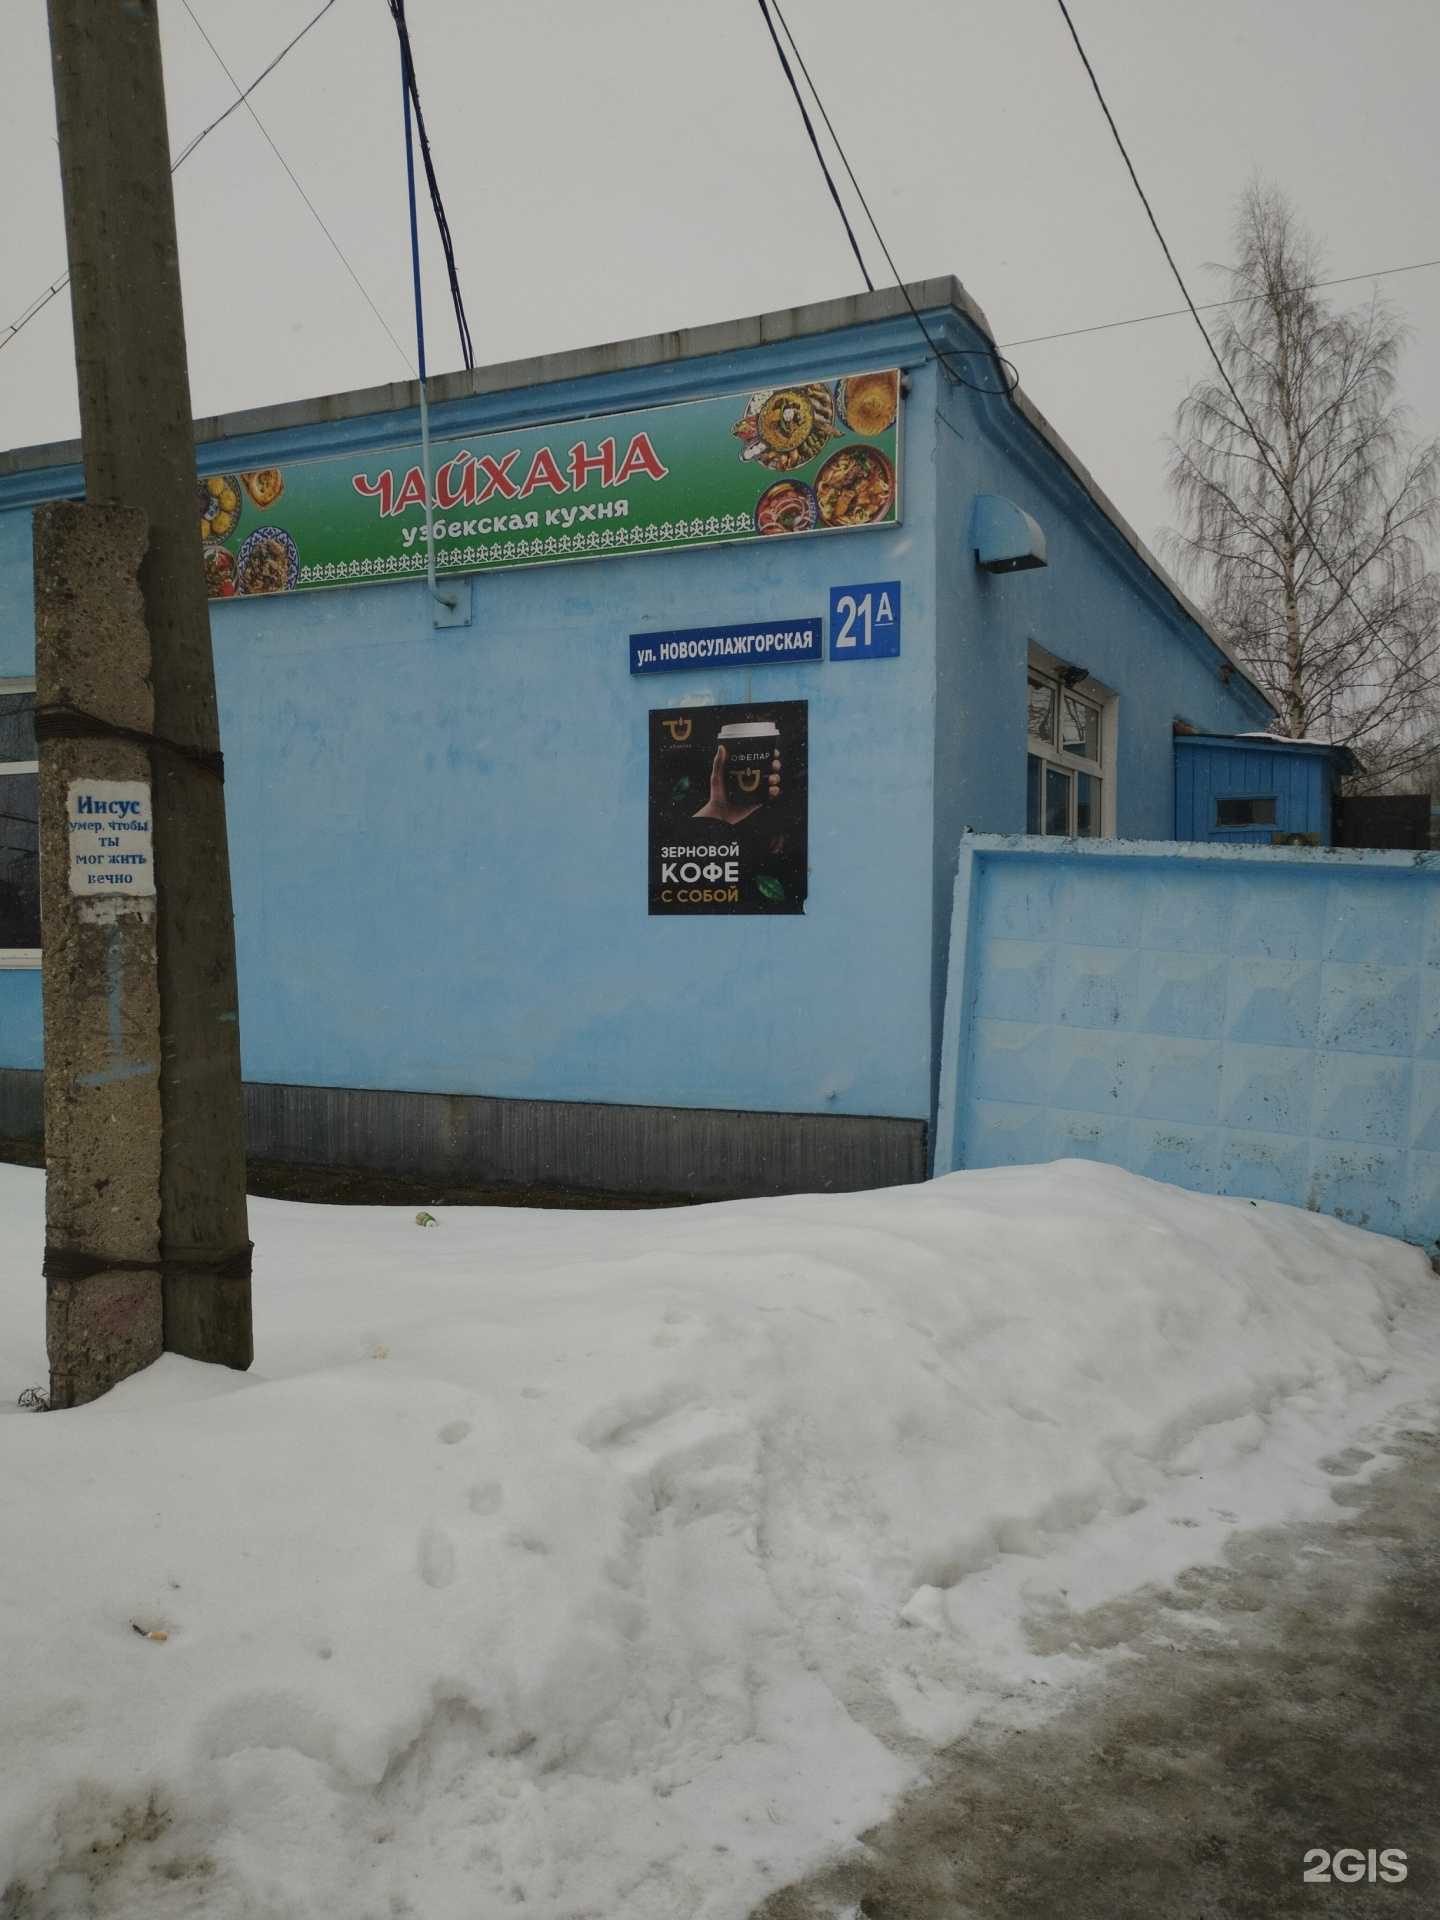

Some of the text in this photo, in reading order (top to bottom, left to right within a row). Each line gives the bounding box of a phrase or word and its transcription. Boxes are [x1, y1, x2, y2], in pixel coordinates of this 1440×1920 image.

[352, 431, 669, 518] ЧАЙХАНА
[401, 498, 629, 548] узбекская кухня
[835, 591, 895, 648] 21А
[637, 630, 813, 666] ул. НОВОСУЛАЖГОРСКАЯ
[77, 796, 141, 818] Иисус
[107, 819, 149, 832] чтобы
[98, 836, 120, 848] ты
[661, 842, 740, 858] ЗЕРНОВОЙ
[76, 854, 147, 865] мог жить
[88, 874, 133, 885] вечно
[661, 861, 740, 883] КОФЕ
[661, 885, 739, 903] С СОБОЙ
